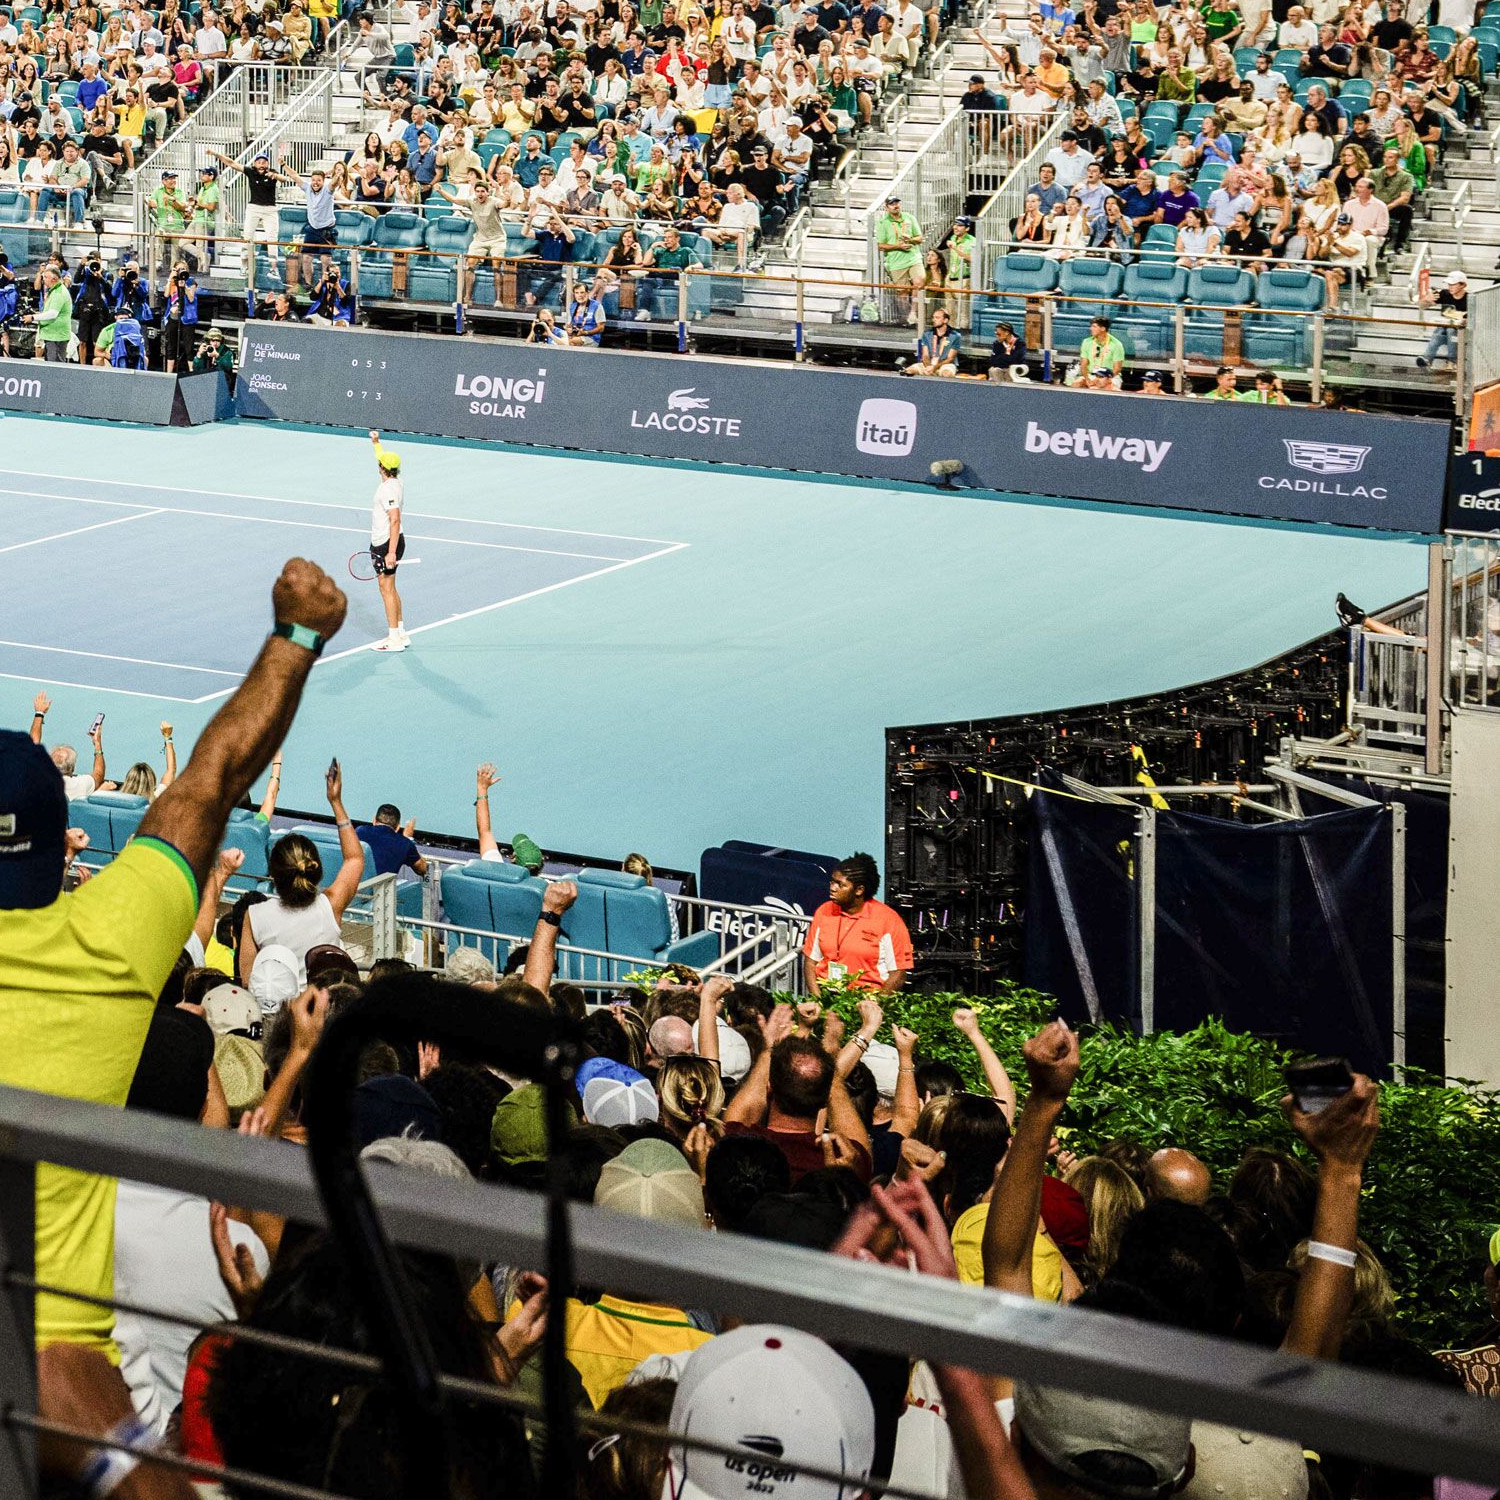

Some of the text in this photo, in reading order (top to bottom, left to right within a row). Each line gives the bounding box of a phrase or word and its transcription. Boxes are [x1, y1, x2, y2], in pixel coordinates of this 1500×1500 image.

[254, 350, 301, 361] DE MINAUR
[255, 343, 275, 351] ALEX
[249, 380, 288, 391] FONSECA
[250, 373, 272, 382] JOAO
[468, 401, 526, 419] SOLAR
[630, 409, 742, 437] LACOSTE
[861, 420, 909, 446] itaú
[1024, 421, 1173, 473] betway
[1471, 459, 1482, 476] 1
[1257, 476, 1388, 500] CADILLAC
[1458, 493, 1500, 511] Elect
[746, 1460, 797, 1483] open
